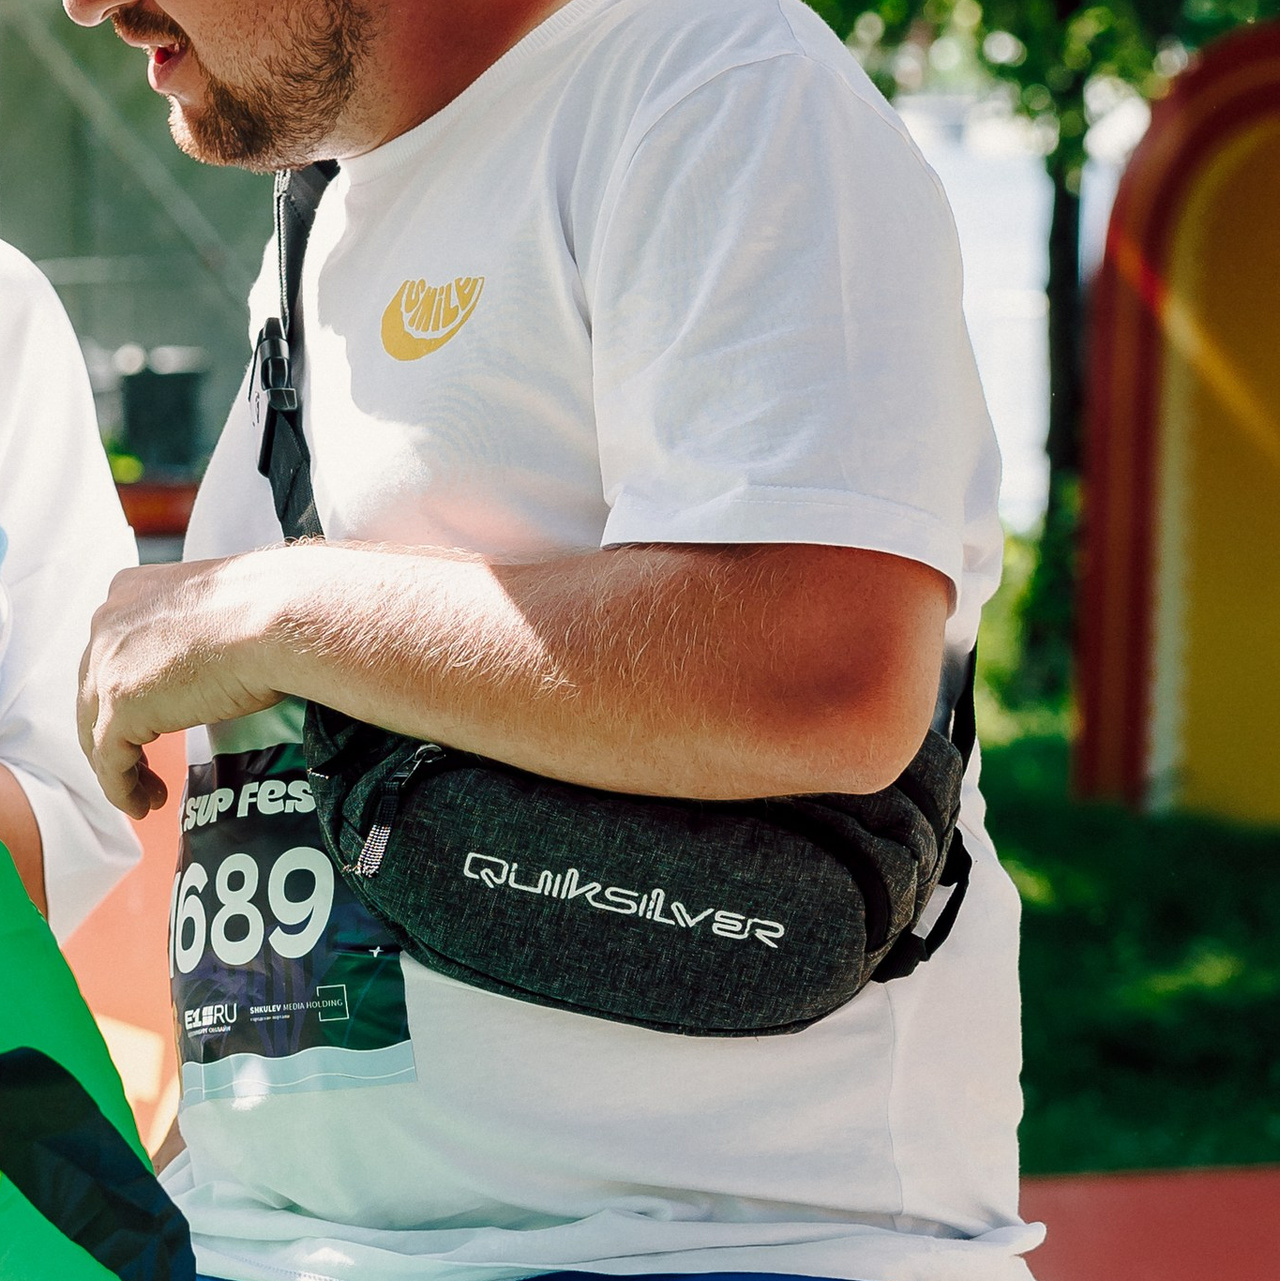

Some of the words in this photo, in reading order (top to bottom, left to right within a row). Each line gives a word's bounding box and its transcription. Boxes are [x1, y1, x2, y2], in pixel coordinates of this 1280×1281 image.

[183, 787, 234, 832] SUP
[236, 779, 317, 818] Fes
[463, 851, 785, 949] QUIKSILVER
[249, 1004, 282, 1015] SHKULEV
[283, 1002, 305, 1012] MEDIA
[306, 998, 343, 1010] HOLDING
